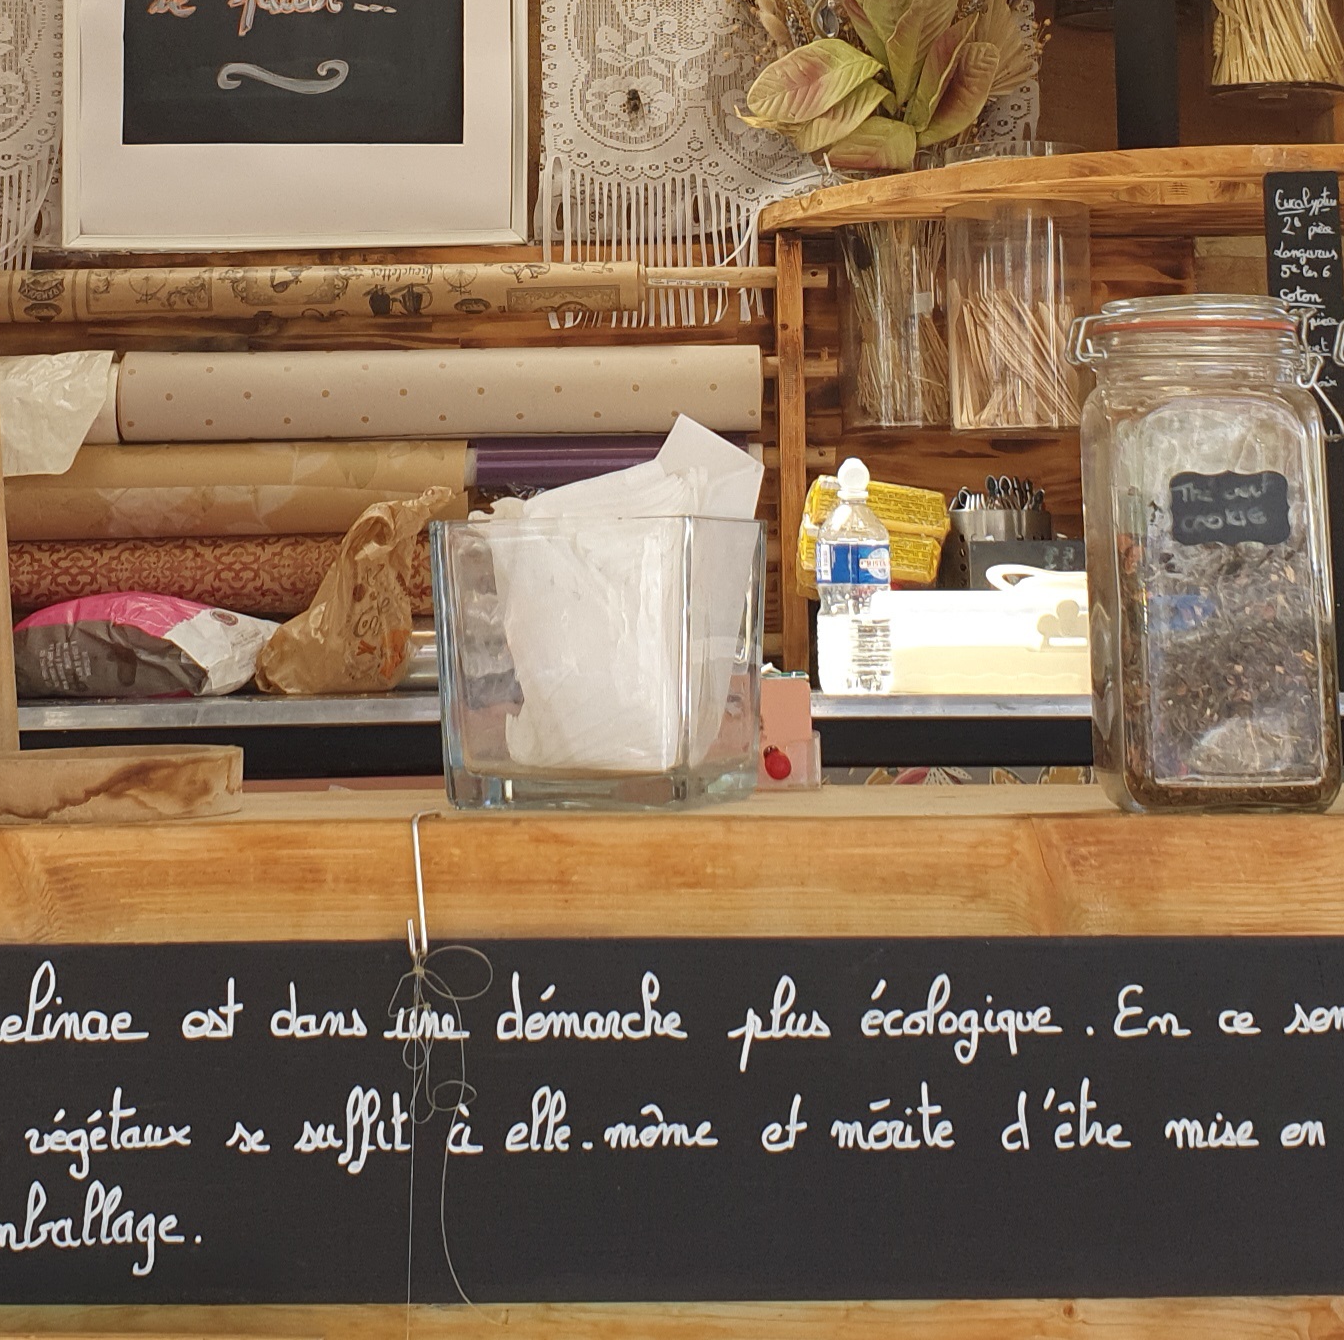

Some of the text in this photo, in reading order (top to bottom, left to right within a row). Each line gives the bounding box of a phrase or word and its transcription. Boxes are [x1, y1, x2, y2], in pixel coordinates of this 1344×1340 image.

[1322, 264, 1331, 278] 6
[270, 981, 368, 1040] dans
[384, 1002, 471, 1040] une
[496, 971, 688, 1041] démarche
[727, 975, 831, 1072] plus
[1112, 984, 1192, 1040] En
[1218, 1006, 1261, 1035] ce
[24, 1086, 193, 1180] végétaux
[225, 1123, 272, 1154] se
[294, 1085, 413, 1175] suffit
[447, 1103, 484, 1154] à
[760, 1094, 808, 1153] et
[830, 1081, 956, 1150] mérite
[1164, 1112, 1261, 1150] mise
[1280, 1124, 1327, 1148] en
